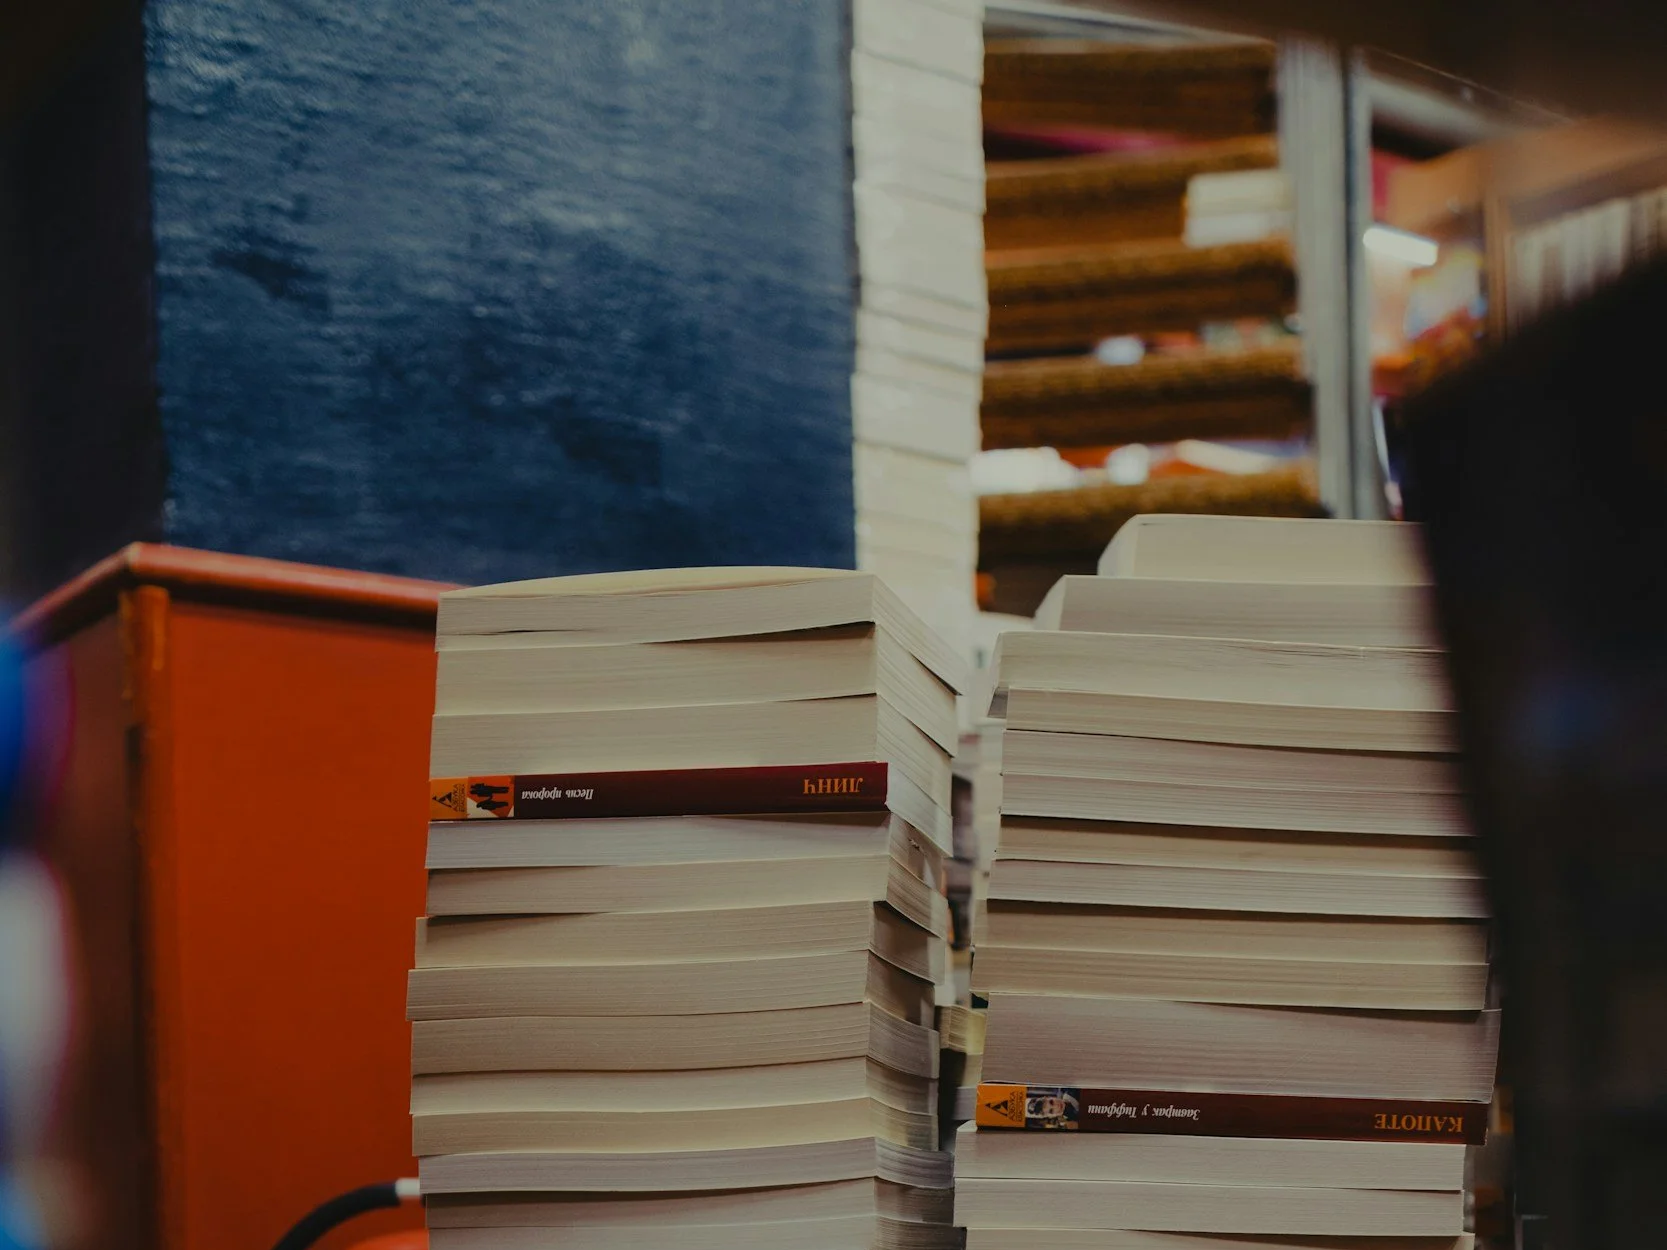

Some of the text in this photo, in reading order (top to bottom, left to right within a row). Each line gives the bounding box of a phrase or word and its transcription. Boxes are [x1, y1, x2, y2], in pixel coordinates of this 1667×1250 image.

[521, 787, 594, 800] Песнь пророка
[803, 777, 864, 795] ЛИНЧ
[1087, 1102, 1201, 1121] Завтрак у Тиффани
[1374, 1113, 1464, 1132] КАПОТЕ
